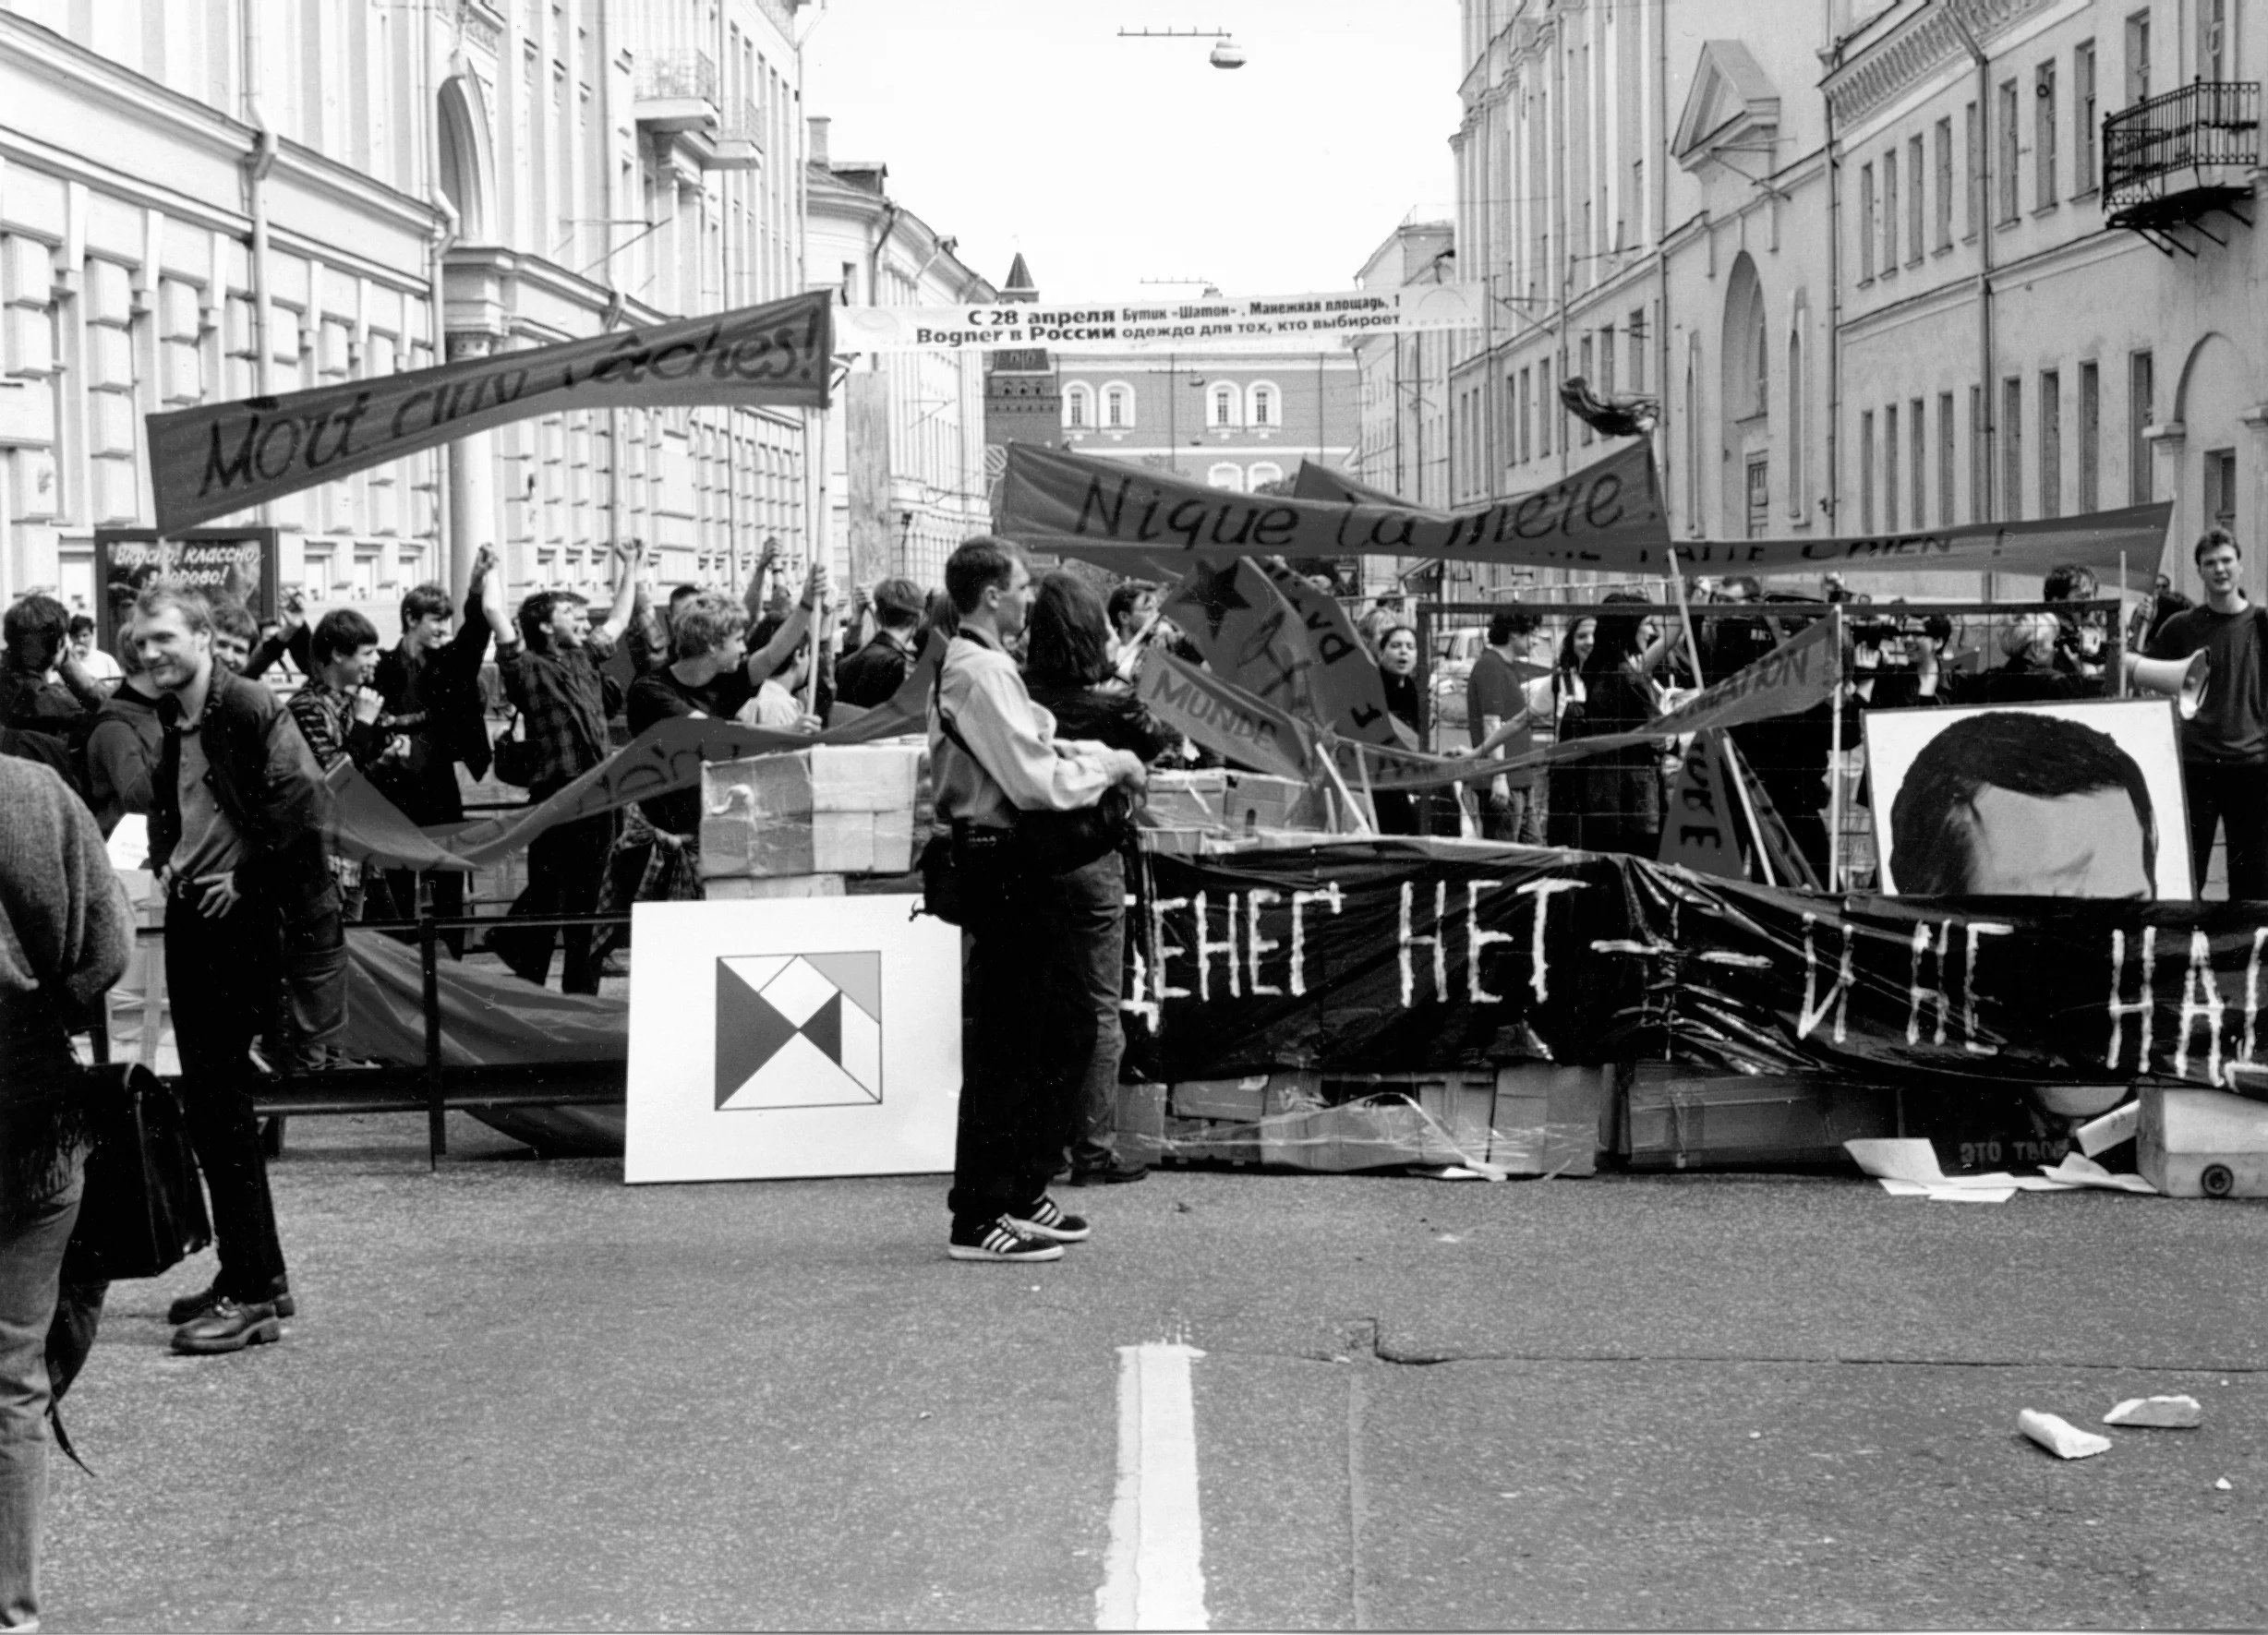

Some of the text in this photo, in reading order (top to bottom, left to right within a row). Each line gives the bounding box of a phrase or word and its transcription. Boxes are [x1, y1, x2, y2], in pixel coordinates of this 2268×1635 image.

[967, 309, 1116, 328] С 28 апреля
[1122, 307, 1167, 323] Бутик
[1249, 300, 1321, 316] Манежная
[916, 327, 1004, 347] Bogner
[1029, 325, 1116, 342] России
[1122, 324, 1195, 340] одежда
[1199, 322, 1234, 337] для
[1277, 319, 1308, 331] кто
[1312, 313, 1401, 331] выбирает
[1074, 472, 1300, 551] Nique
[1398, 878, 1592, 1009] НЕТ
[1903, 919, 2014, 1057] НЕ
